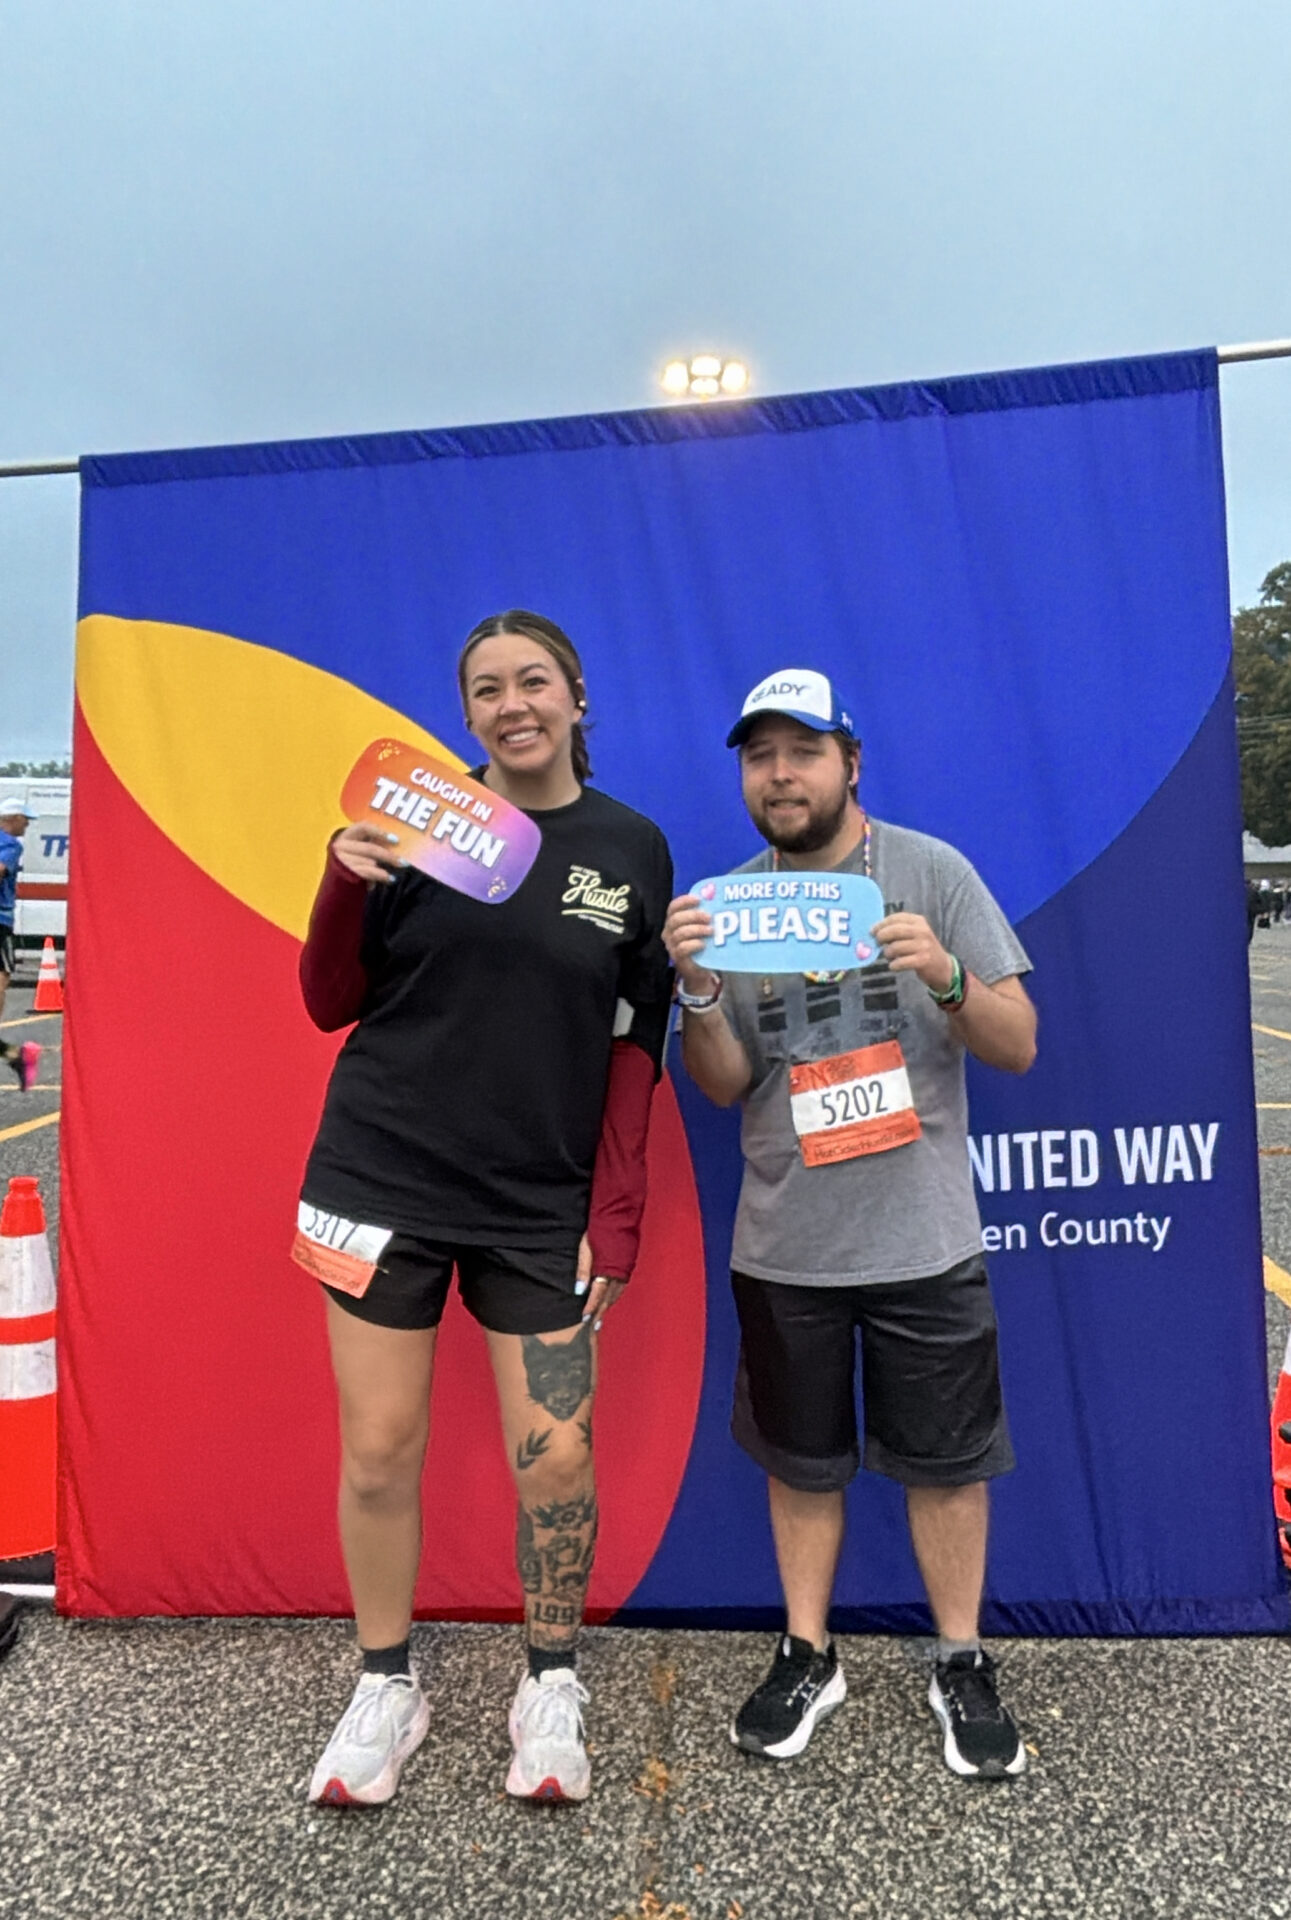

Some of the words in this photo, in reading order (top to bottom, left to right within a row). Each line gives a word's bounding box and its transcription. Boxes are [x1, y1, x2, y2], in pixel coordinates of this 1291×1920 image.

[409, 768, 475, 809] CAUGHT
[471, 800, 494, 822] IN
[370, 776, 438, 831] THE
[432, 810, 507, 869] FUN
[561, 872, 631, 913] Hustle
[724, 882, 774, 902] MORE
[777, 881, 800, 899] OF
[802, 881, 841, 900] THIS
[713, 906, 851, 947] PLEASE
[820, 1079, 888, 1126] 5202
[1113, 1122, 1220, 1186] WAY
[1040, 1210, 1172, 1252] County
